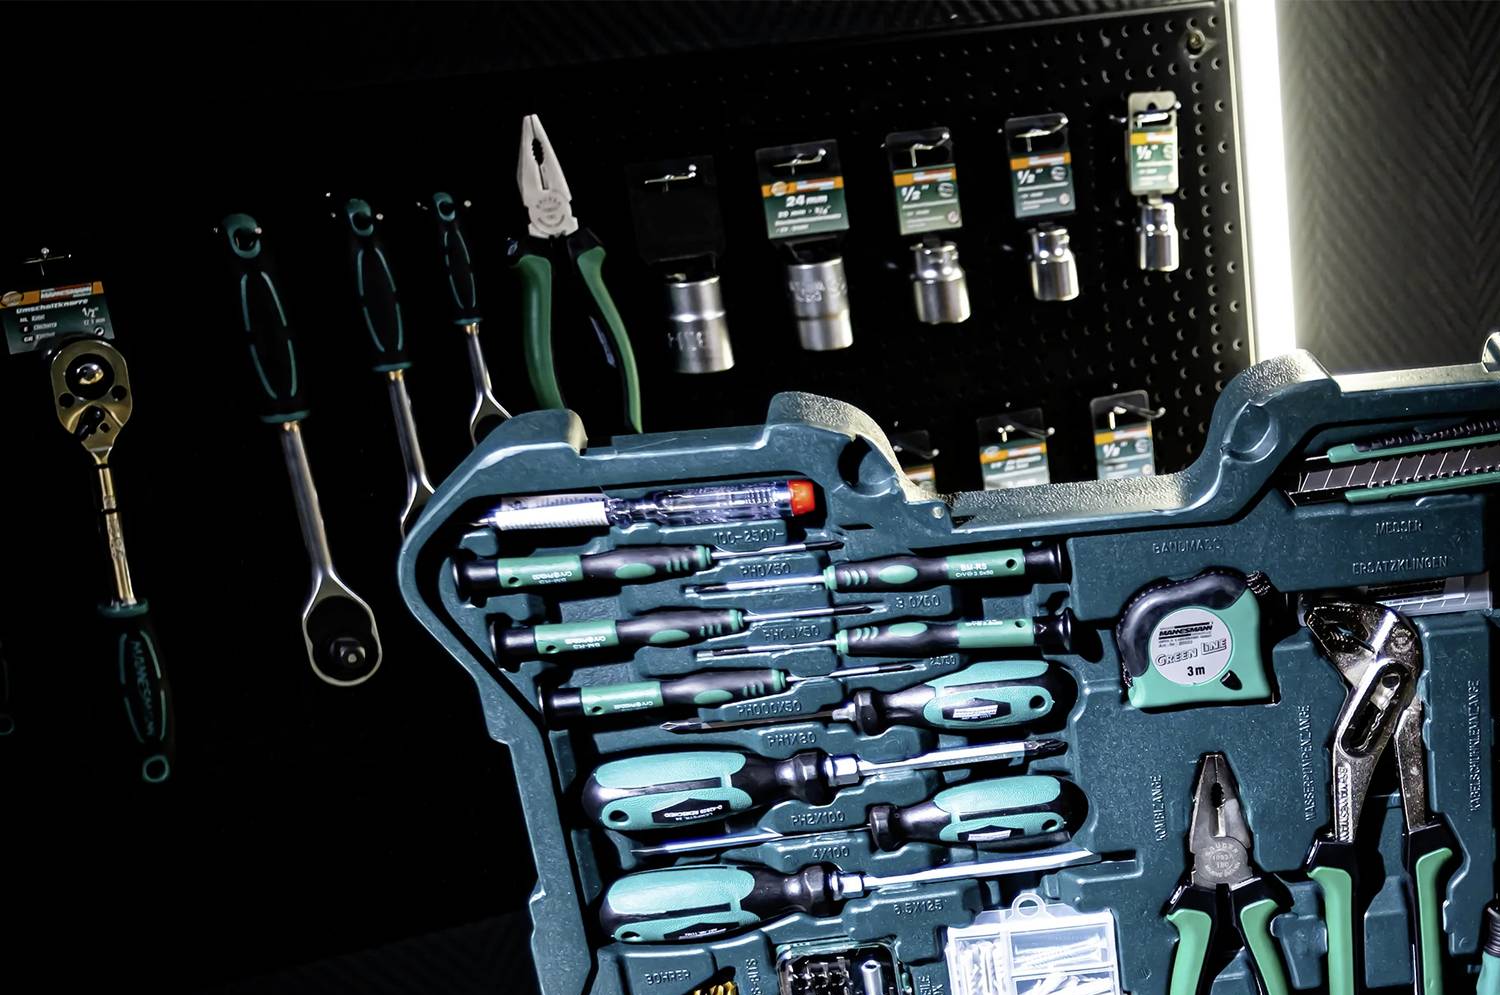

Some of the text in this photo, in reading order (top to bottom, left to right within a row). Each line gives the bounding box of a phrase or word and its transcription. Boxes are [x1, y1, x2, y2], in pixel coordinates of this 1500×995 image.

[785, 194, 805, 208] 24
[16, 298, 89, 314] Umschaltknarre
[1374, 519, 1422, 536] MESSER
[1351, 554, 1449, 577] ERSATZKLINGEN
[1158, 624, 1214, 637] MANNESMANN
[790, 811, 846, 827] PH2X100
[644, 968, 691, 986] BOHRER
